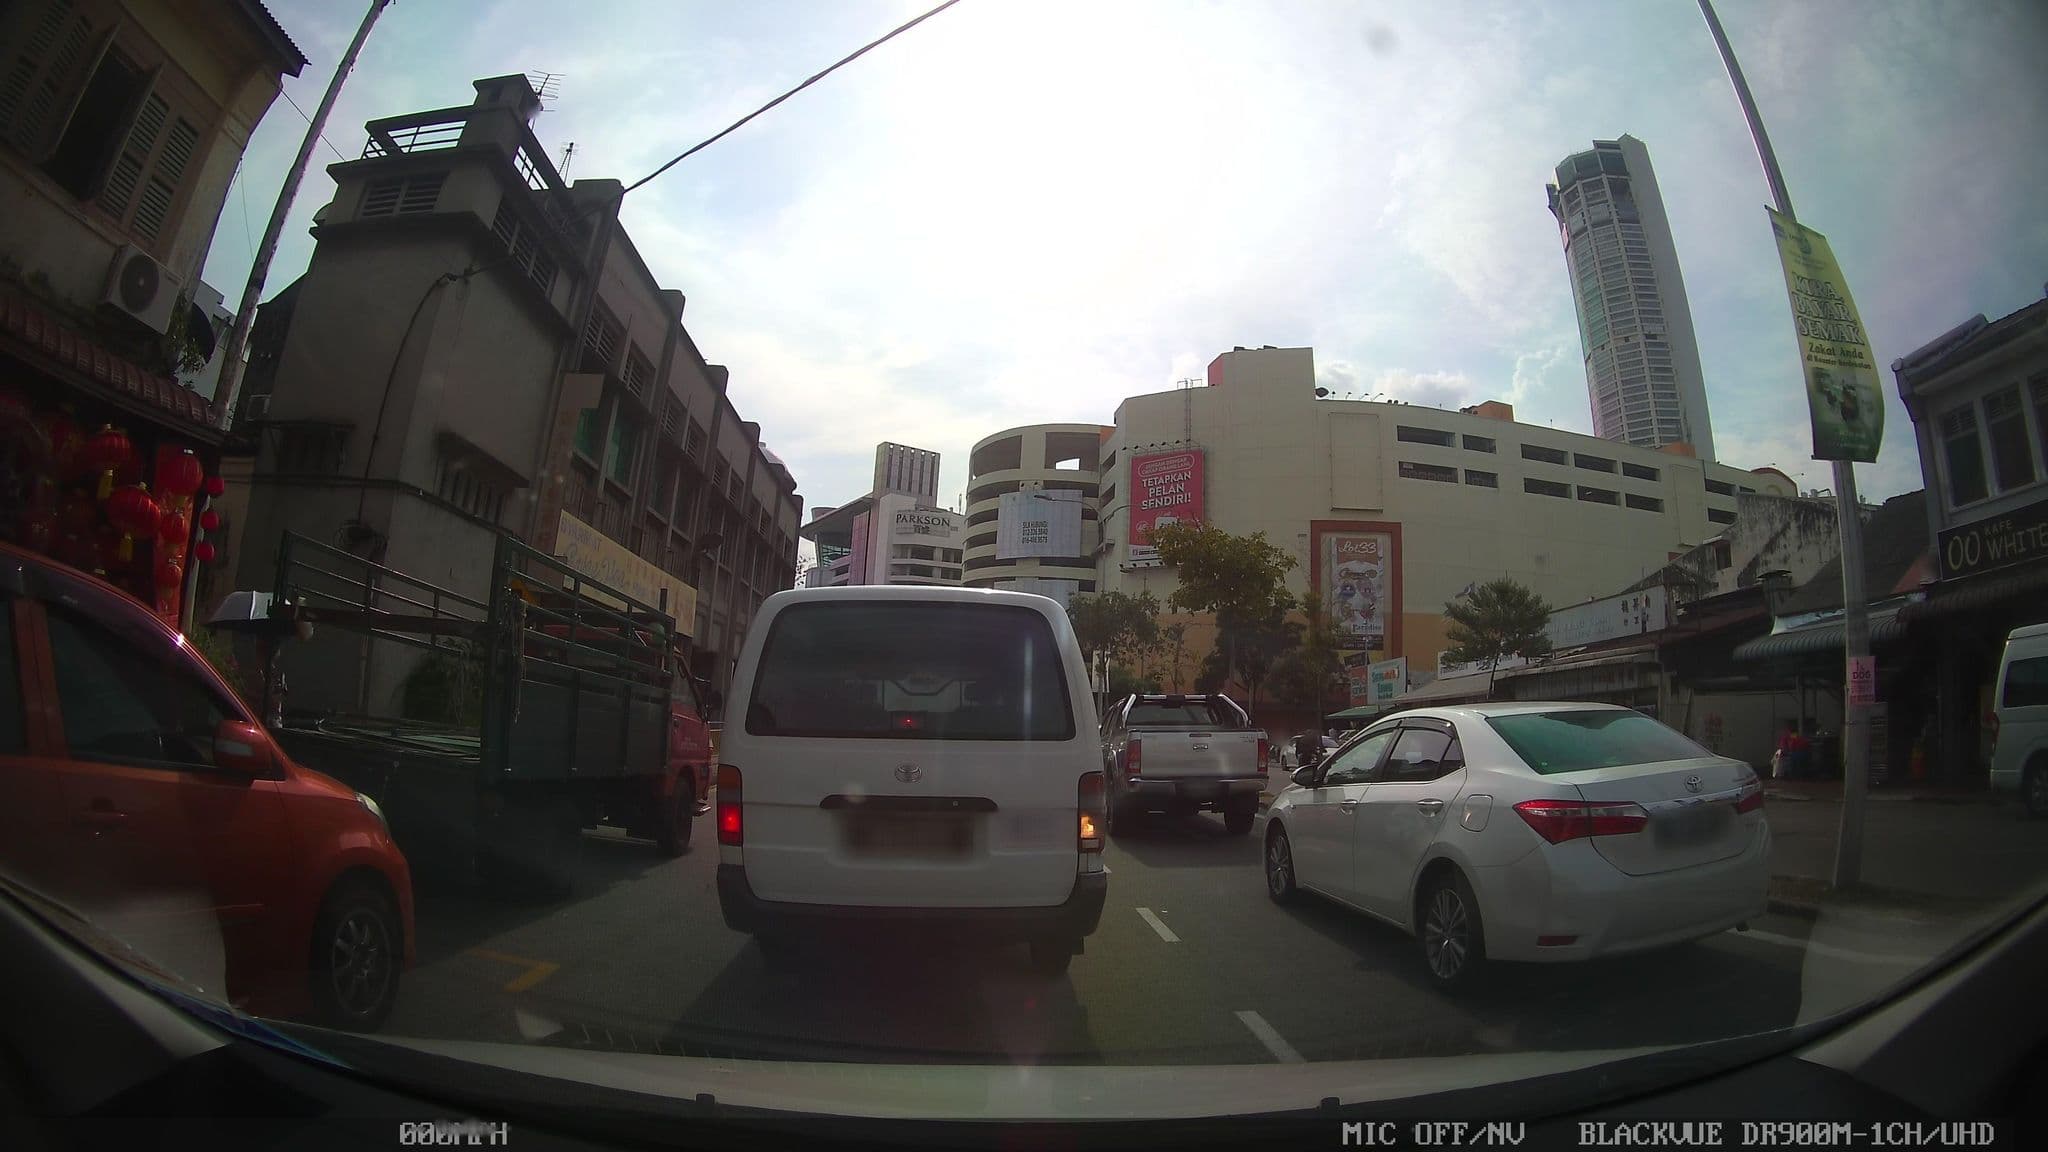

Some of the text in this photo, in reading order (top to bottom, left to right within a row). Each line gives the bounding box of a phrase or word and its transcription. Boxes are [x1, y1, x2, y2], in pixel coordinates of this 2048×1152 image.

[1796, 314, 1865, 345] SEMAK
[1808, 341, 1864, 360] Zakat Anda
[1142, 470, 1191, 488] TETAPKAN
[1149, 483, 1185, 498] PELAN
[1141, 493, 1191, 510] SENDIRI!
[896, 513, 950, 527] PARKSON
[1984, 520, 2013, 536] KAFE
[1986, 522, 2048, 560] WHITE
